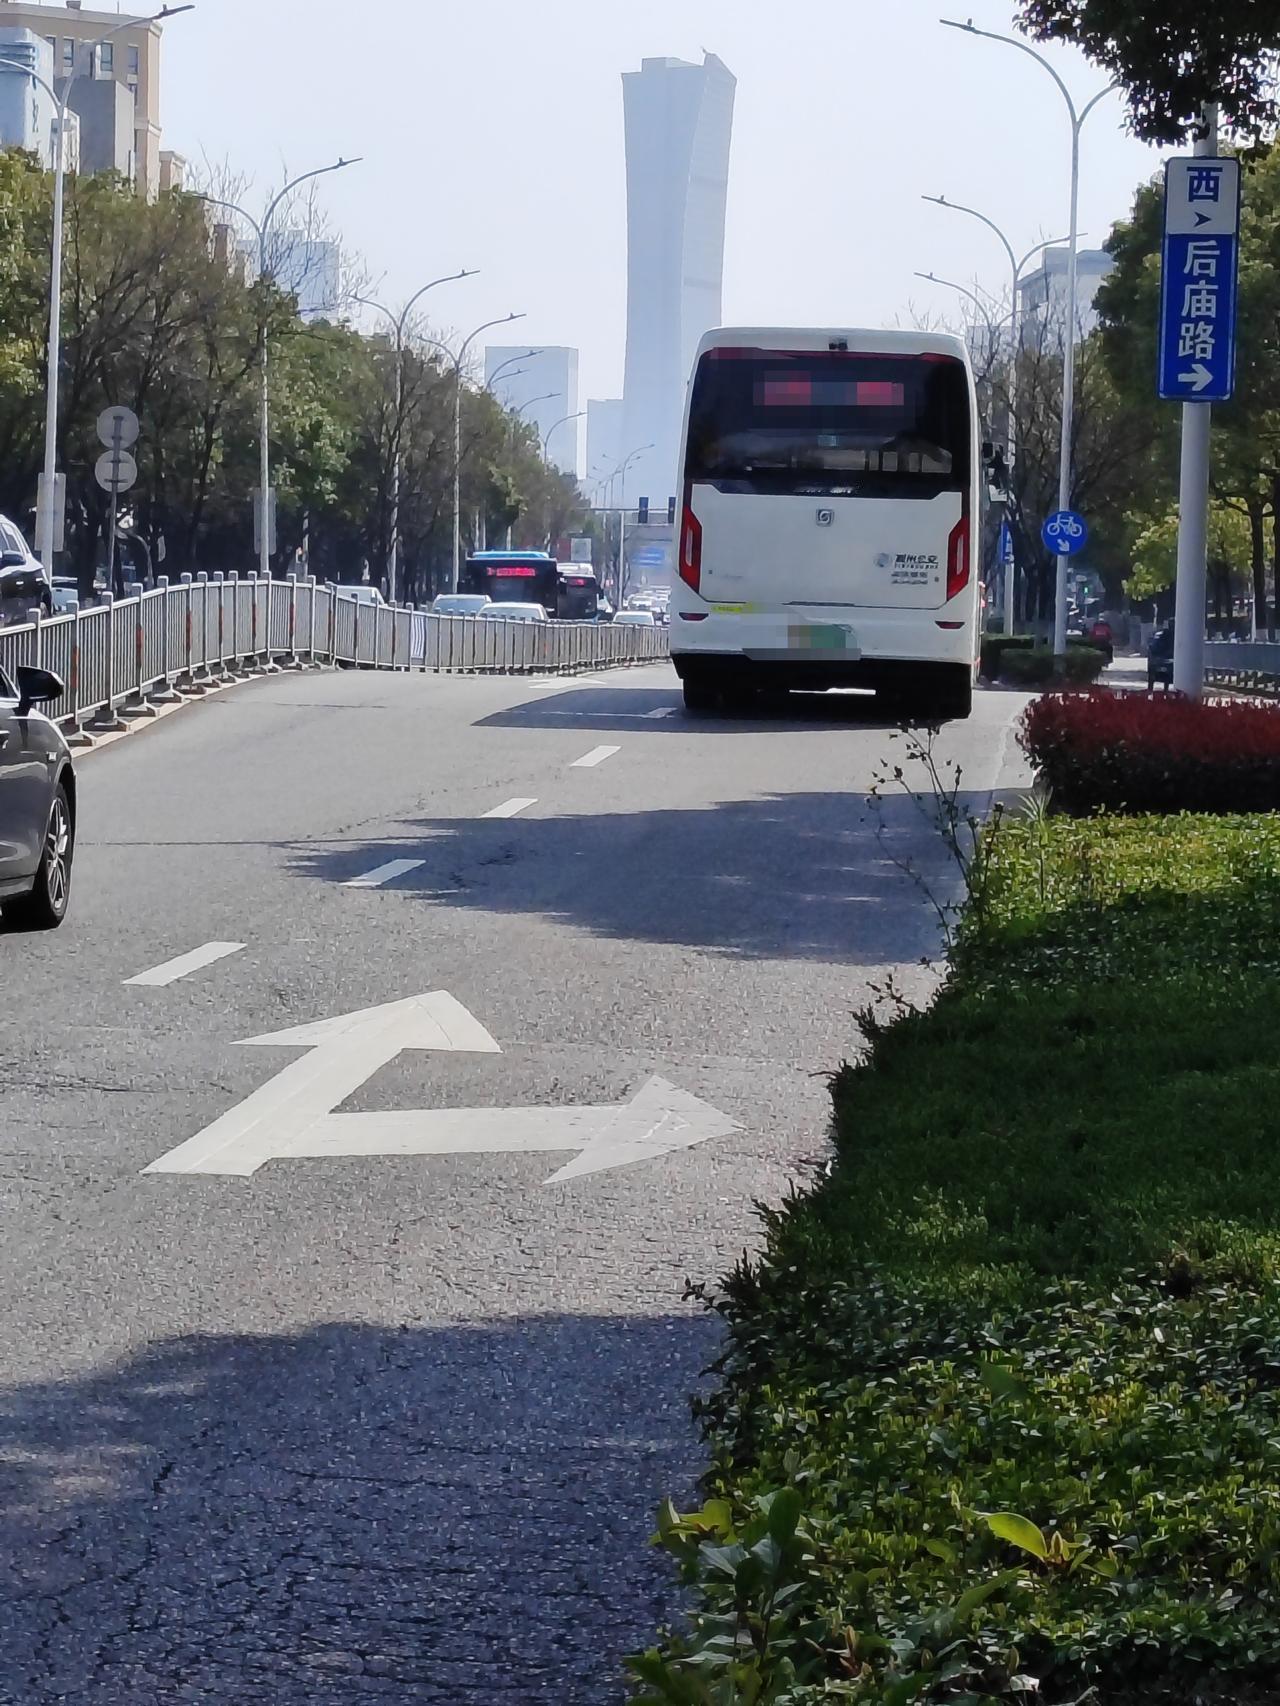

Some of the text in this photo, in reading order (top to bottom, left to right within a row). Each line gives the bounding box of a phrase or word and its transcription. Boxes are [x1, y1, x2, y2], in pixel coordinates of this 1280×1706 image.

[1186, 166, 1223, 203] 西
[1178, 239, 1221, 360] 后庙路
